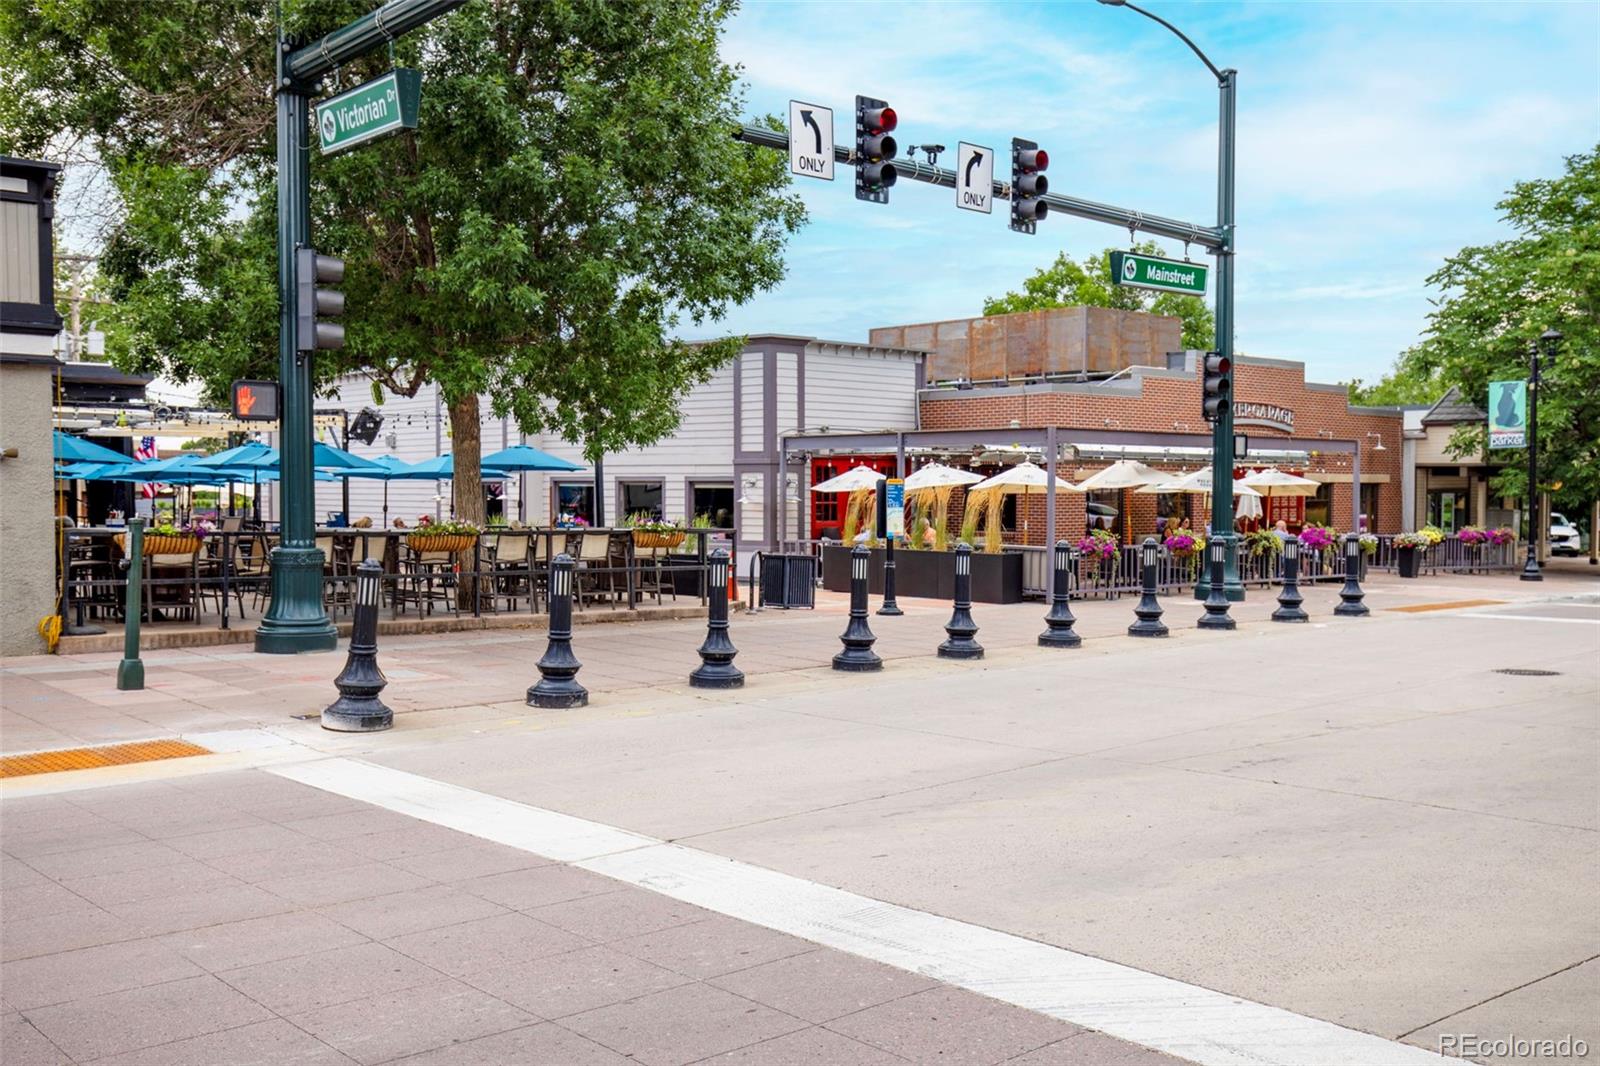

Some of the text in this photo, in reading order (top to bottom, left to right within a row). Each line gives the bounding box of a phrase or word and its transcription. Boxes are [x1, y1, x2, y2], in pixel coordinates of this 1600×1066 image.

[336, 89, 395, 132] Victorian Dr
[799, 155, 826, 173] ONLY
[963, 191, 986, 207] ONLY
[1146, 264, 1195, 286] Mainstreet
[1252, 404, 1294, 425] GARAGE
[1490, 435, 1523, 448] parker
